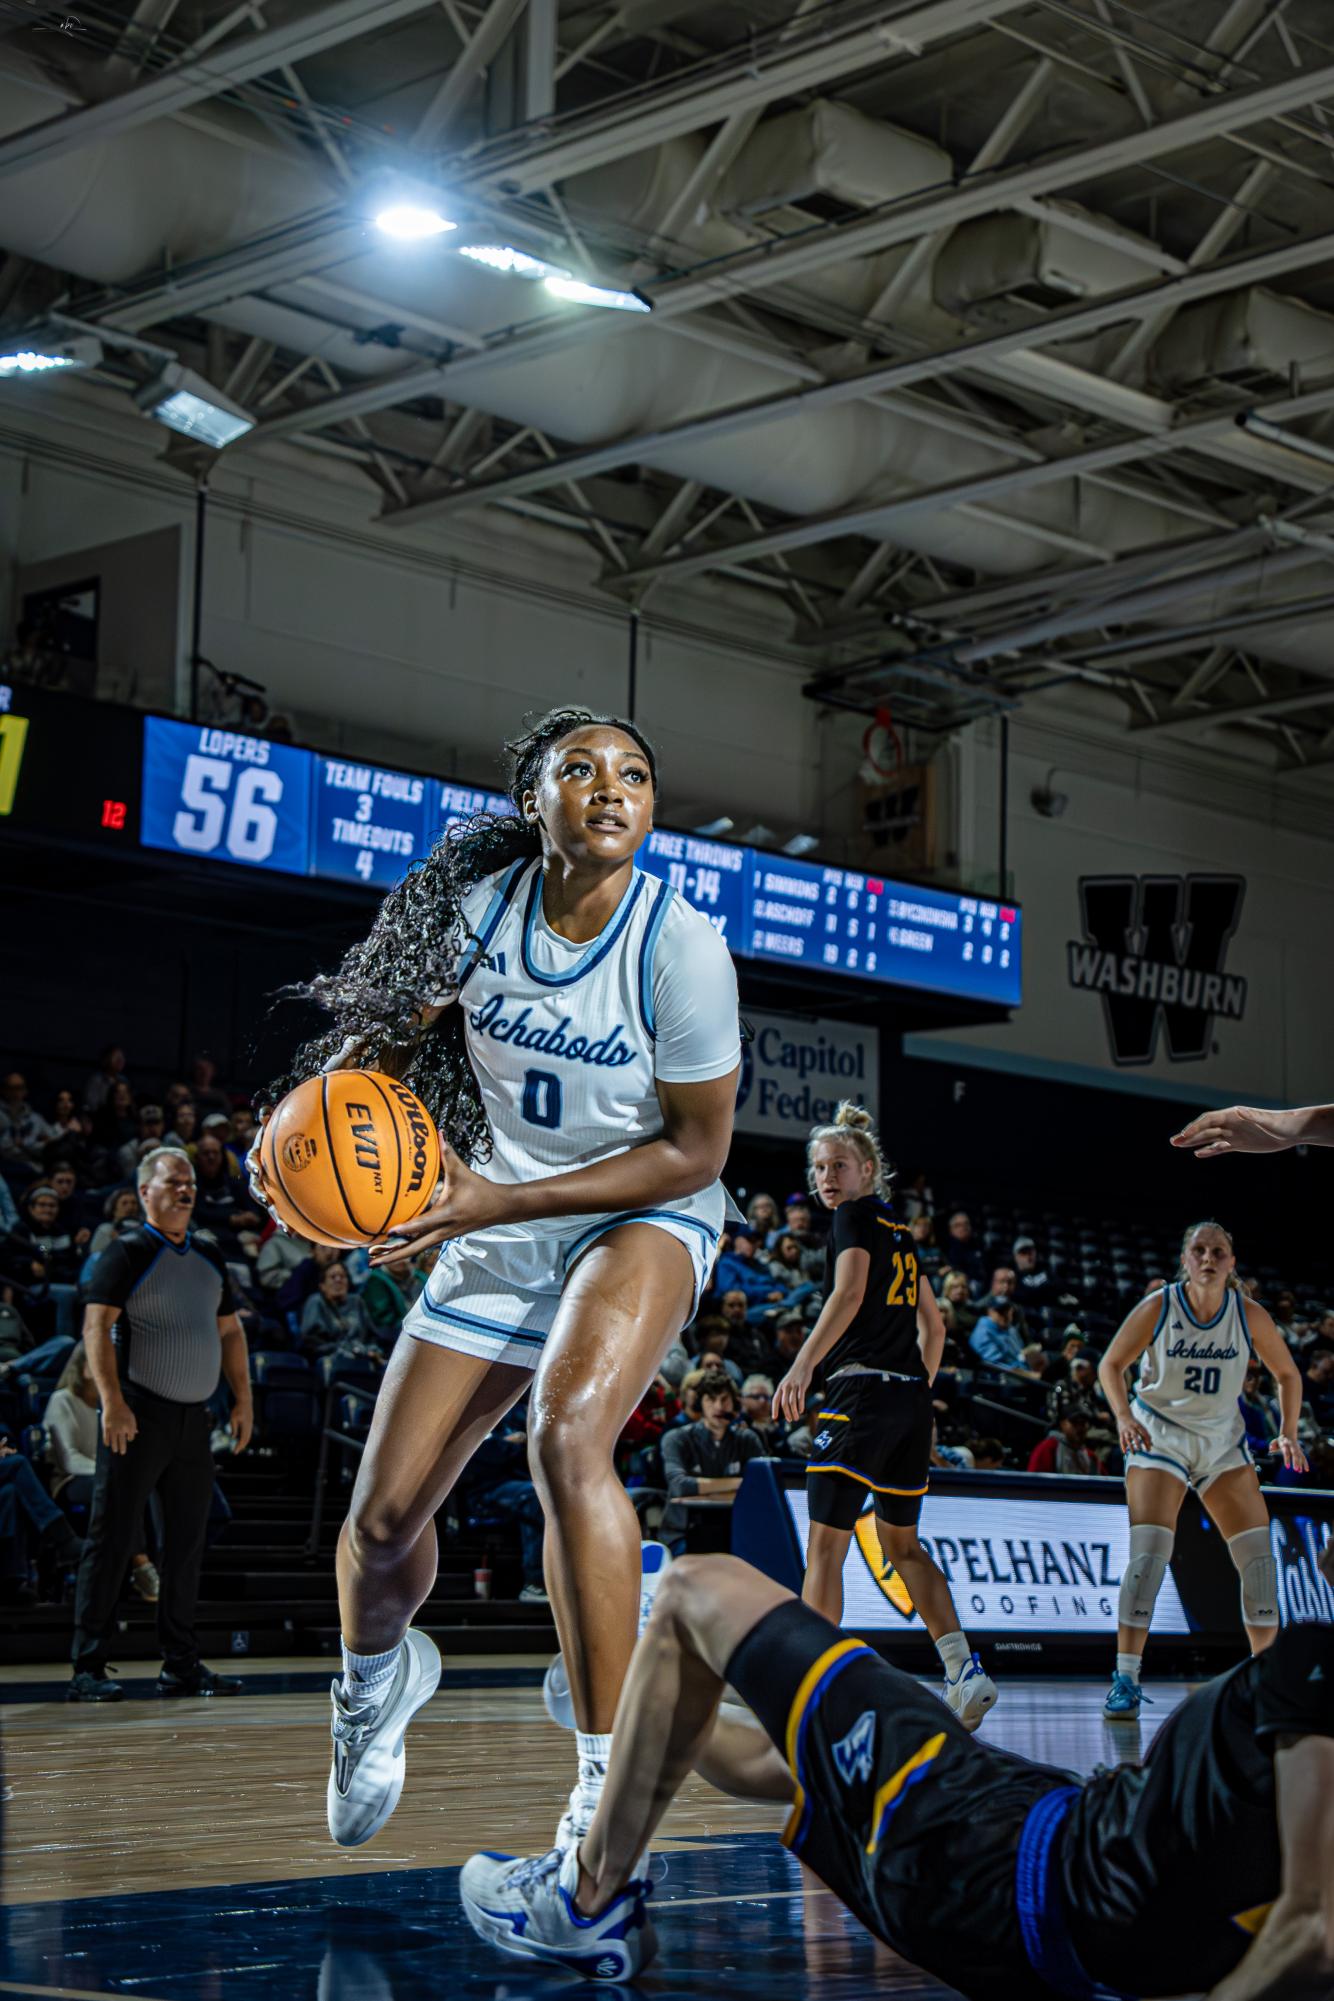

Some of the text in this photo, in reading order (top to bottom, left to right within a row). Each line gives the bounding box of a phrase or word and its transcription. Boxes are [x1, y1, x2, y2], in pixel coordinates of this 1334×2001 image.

[199, 728, 271, 765] LOPERS
[325, 762, 424, 805] TEAM FOULS
[101, 800, 127, 829] 12
[172, 753, 284, 863] 56
[354, 794, 374, 823] 3
[332, 818, 415, 857] TIMEOUTS
[648, 831, 743, 872] FREE THROWS
[355, 851, 374, 881] 4
[1067, 943, 1245, 1018] WASHBURN
[470, 994, 638, 1067] Ichabods
[758, 1027, 866, 1080] Capitol
[522, 1068, 562, 1129] 0
[757, 1078, 866, 1124] Feder
[389, 1083, 429, 1193] Wilson
[886, 1252, 918, 1306] 23
[1167, 1340, 1240, 1360] Ichabods
[1184, 1366, 1221, 1394] 20
